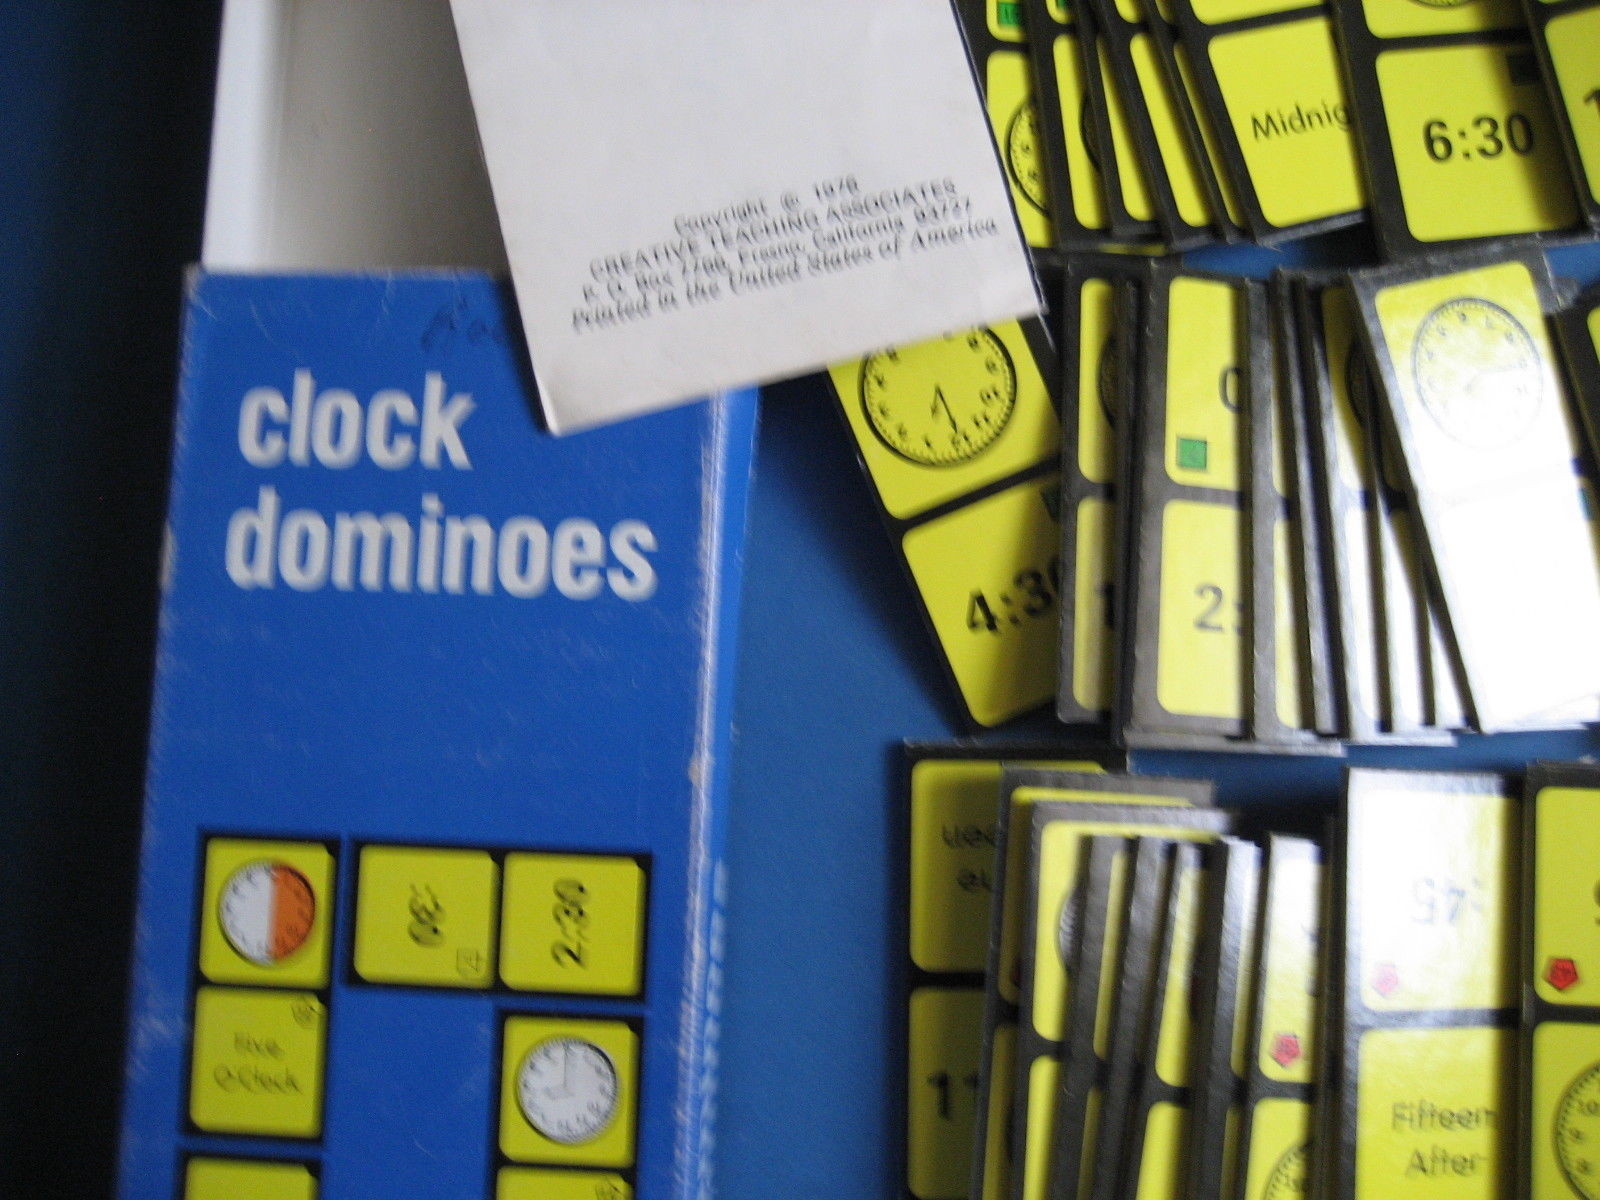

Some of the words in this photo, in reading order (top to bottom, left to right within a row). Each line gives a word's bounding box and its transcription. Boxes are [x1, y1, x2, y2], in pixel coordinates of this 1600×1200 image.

[1423, 111, 1535, 164] 6:30
[590, 236, 699, 278] CREATIVE
[706, 207, 821, 252] TEACHING
[826, 176, 957, 222] ASSOCIATES
[634, 267, 674, 292] Box
[812, 214, 906, 253] California
[674, 195, 766, 234] Copyright
[571, 287, 652, 332] Printed
[657, 288, 680, 313] in
[686, 277, 720, 307] the
[729, 254, 801, 295] United
[807, 246, 873, 278] States
[879, 230, 904, 262] of
[911, 214, 999, 252] America
[237, 366, 477, 471] clock
[223, 484, 658, 602] dominoes
[1391, 1100, 1500, 1134] Fifteen
[1405, 1145, 1488, 1179] After
